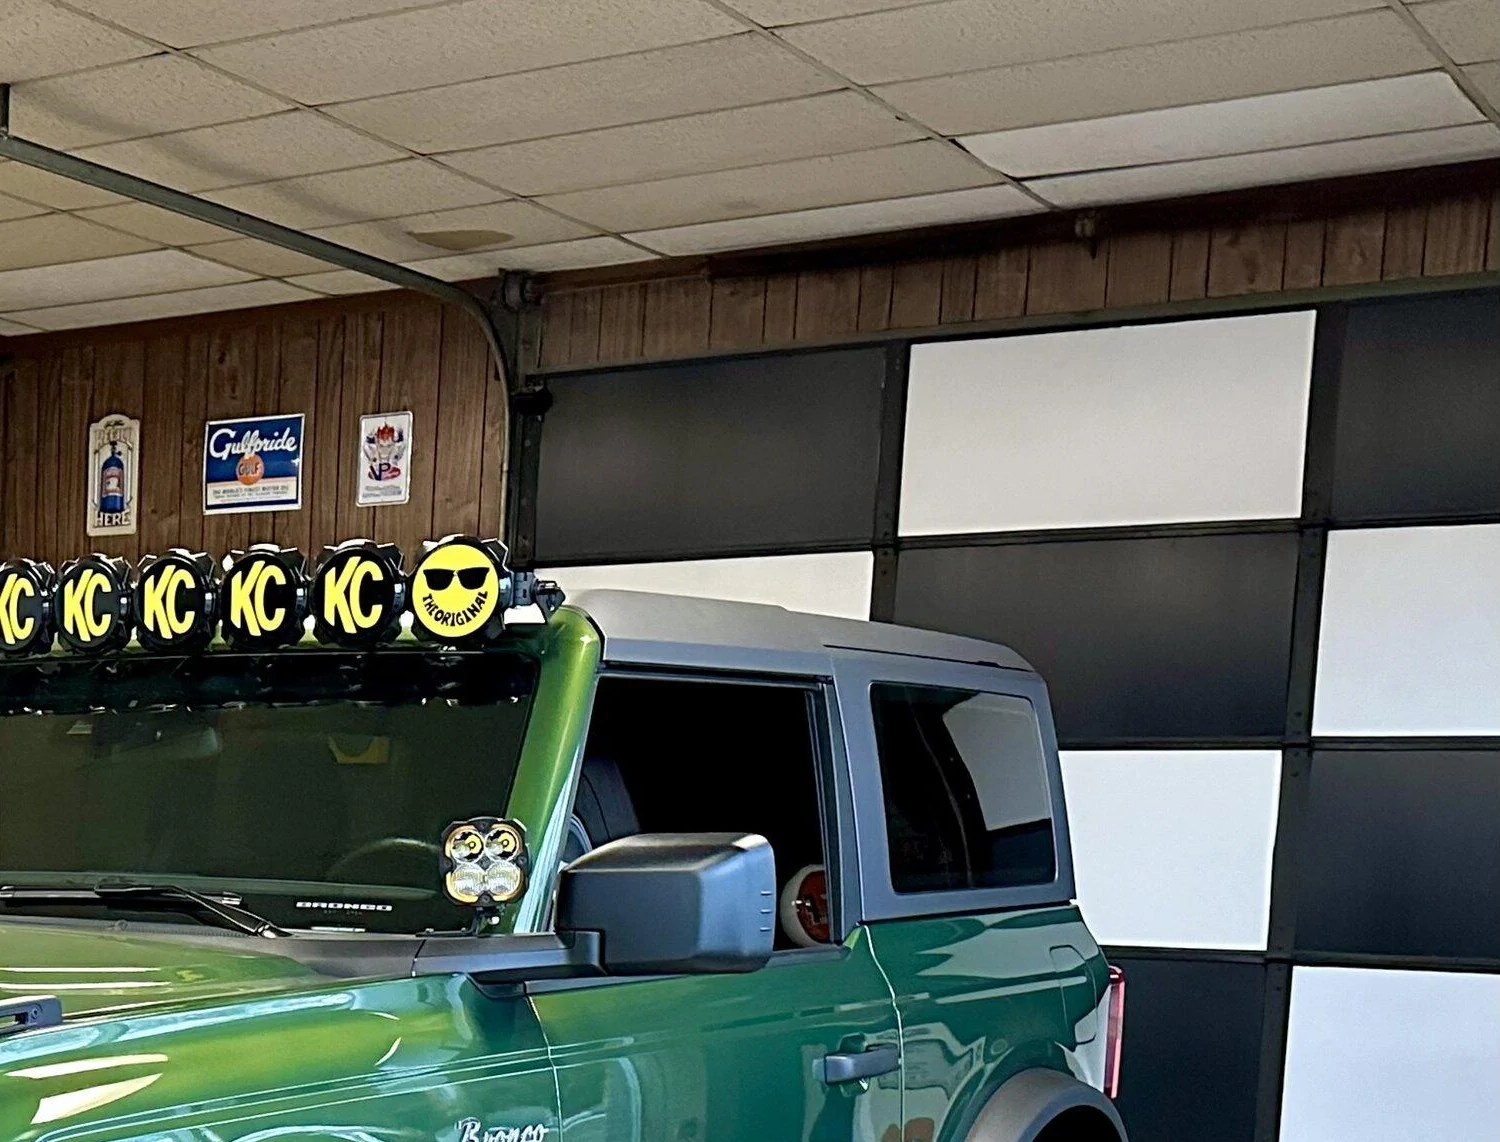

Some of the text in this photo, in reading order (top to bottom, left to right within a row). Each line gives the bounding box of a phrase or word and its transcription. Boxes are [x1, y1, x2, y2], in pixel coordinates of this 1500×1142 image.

[209, 427, 297, 460] Gulfpride
[93, 509, 132, 529] HERE
[64, 569, 112, 642] KC
[143, 565, 195, 639] KC
[230, 560, 286, 637] KC
[324, 556, 383, 634] KC
[296, 901, 393, 911] BRONCO
